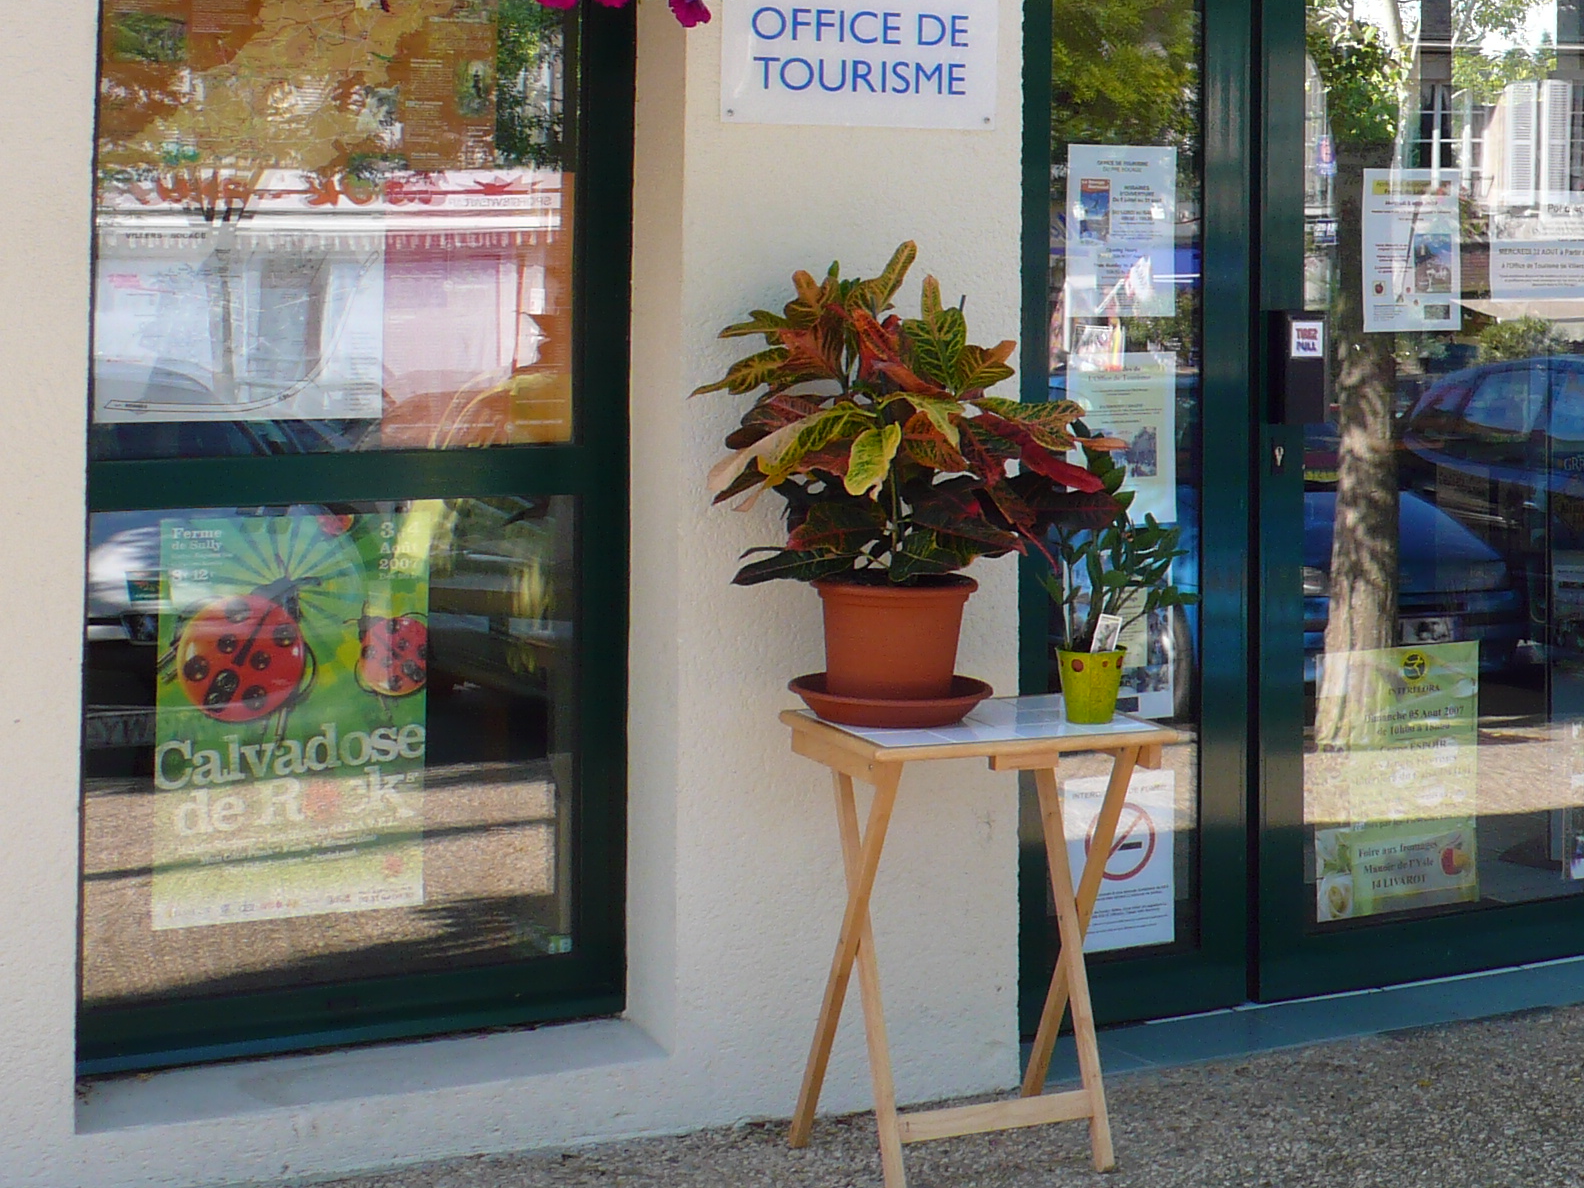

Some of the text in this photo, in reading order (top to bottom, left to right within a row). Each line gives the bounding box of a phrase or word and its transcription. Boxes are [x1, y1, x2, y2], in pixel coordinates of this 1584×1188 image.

[751, 6, 969, 48] OFFICE DE
[754, 56, 967, 96] TOURISME
[1296, 341, 1317, 352] PULL
[171, 527, 223, 539] Ferme
[171, 539, 223, 552] de Sully
[379, 558, 418, 570] 2007
[1443, 704, 1465, 717] 2007
[154, 723, 426, 791] Calvadose
[174, 788, 247, 837] de
